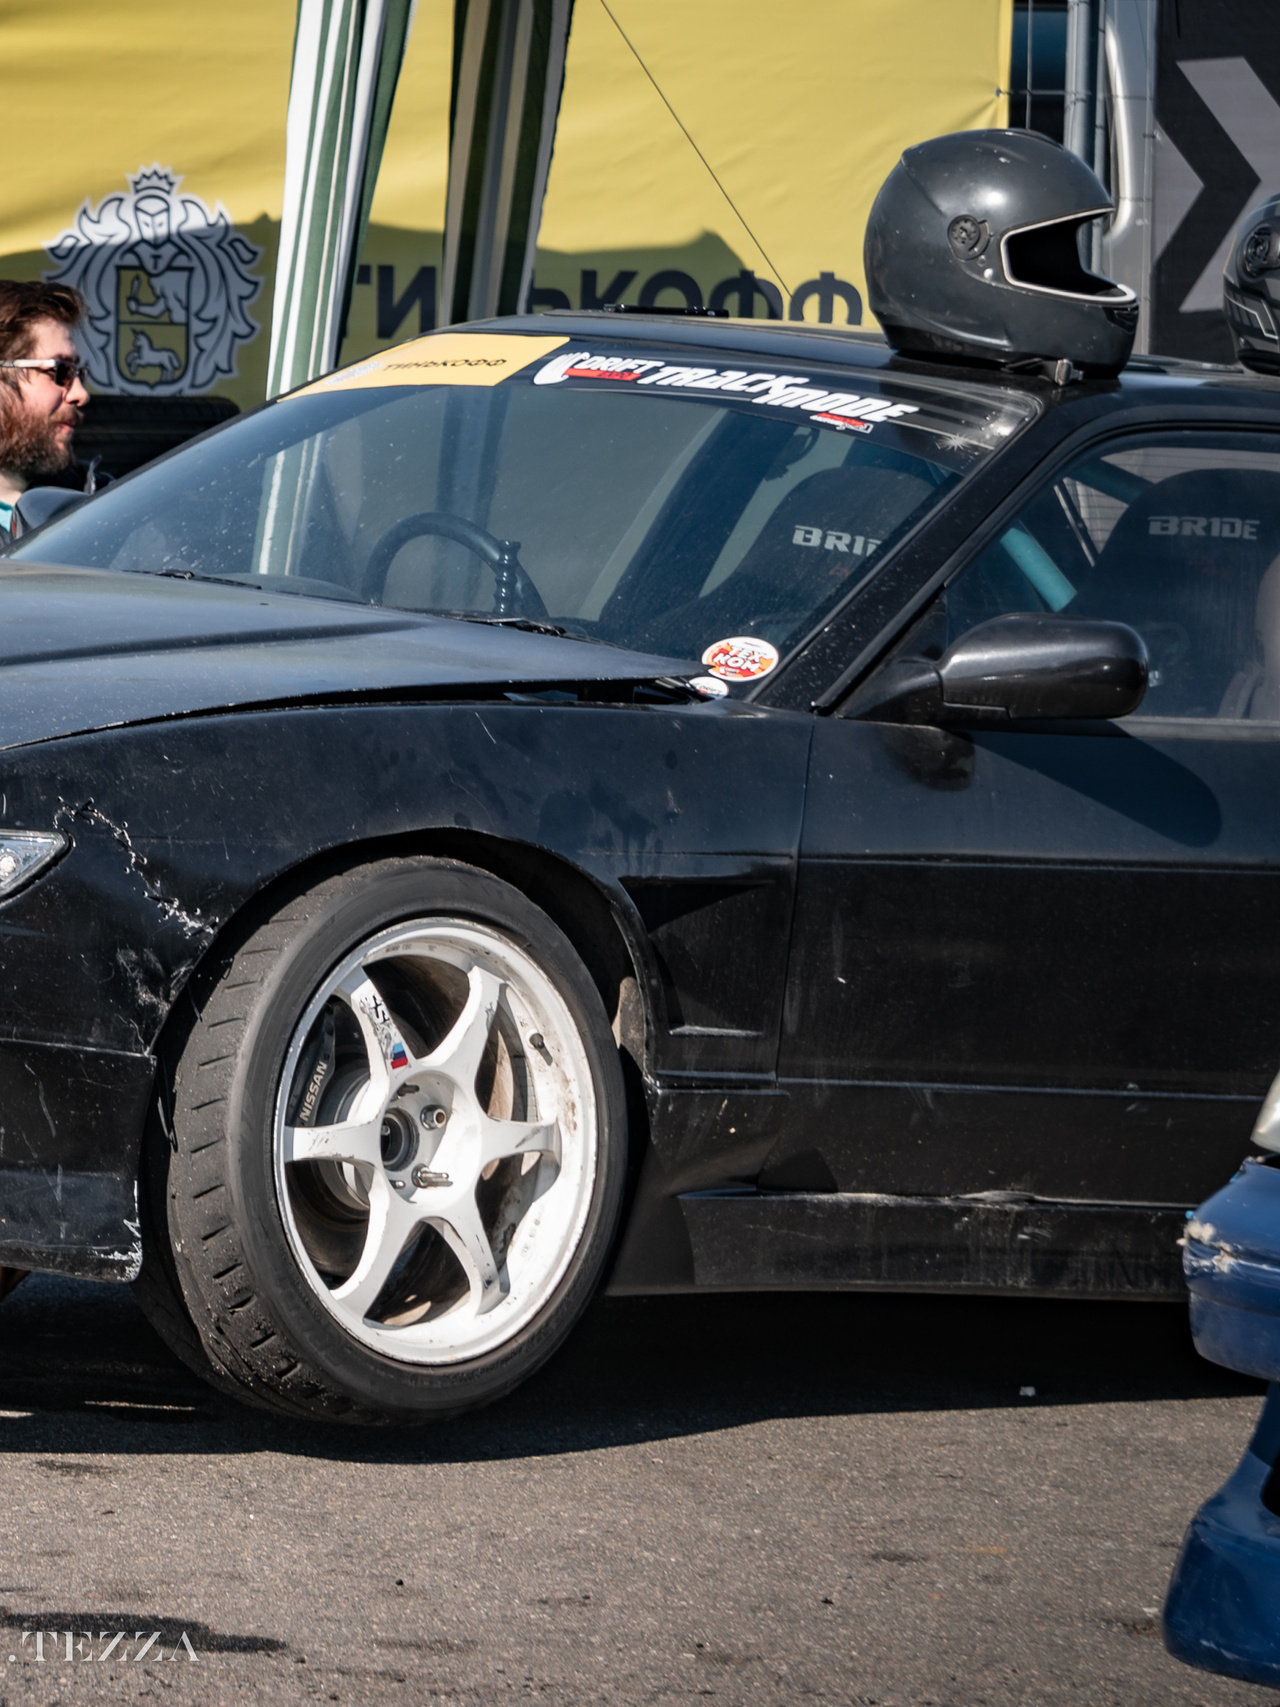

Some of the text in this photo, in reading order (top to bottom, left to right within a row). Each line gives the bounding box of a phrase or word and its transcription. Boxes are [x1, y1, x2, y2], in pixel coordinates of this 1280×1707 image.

[573, 355, 665, 374] DRIFT
[1147, 515, 1260, 540] BRIDE
[299, 1060, 328, 1122] NISSAN
